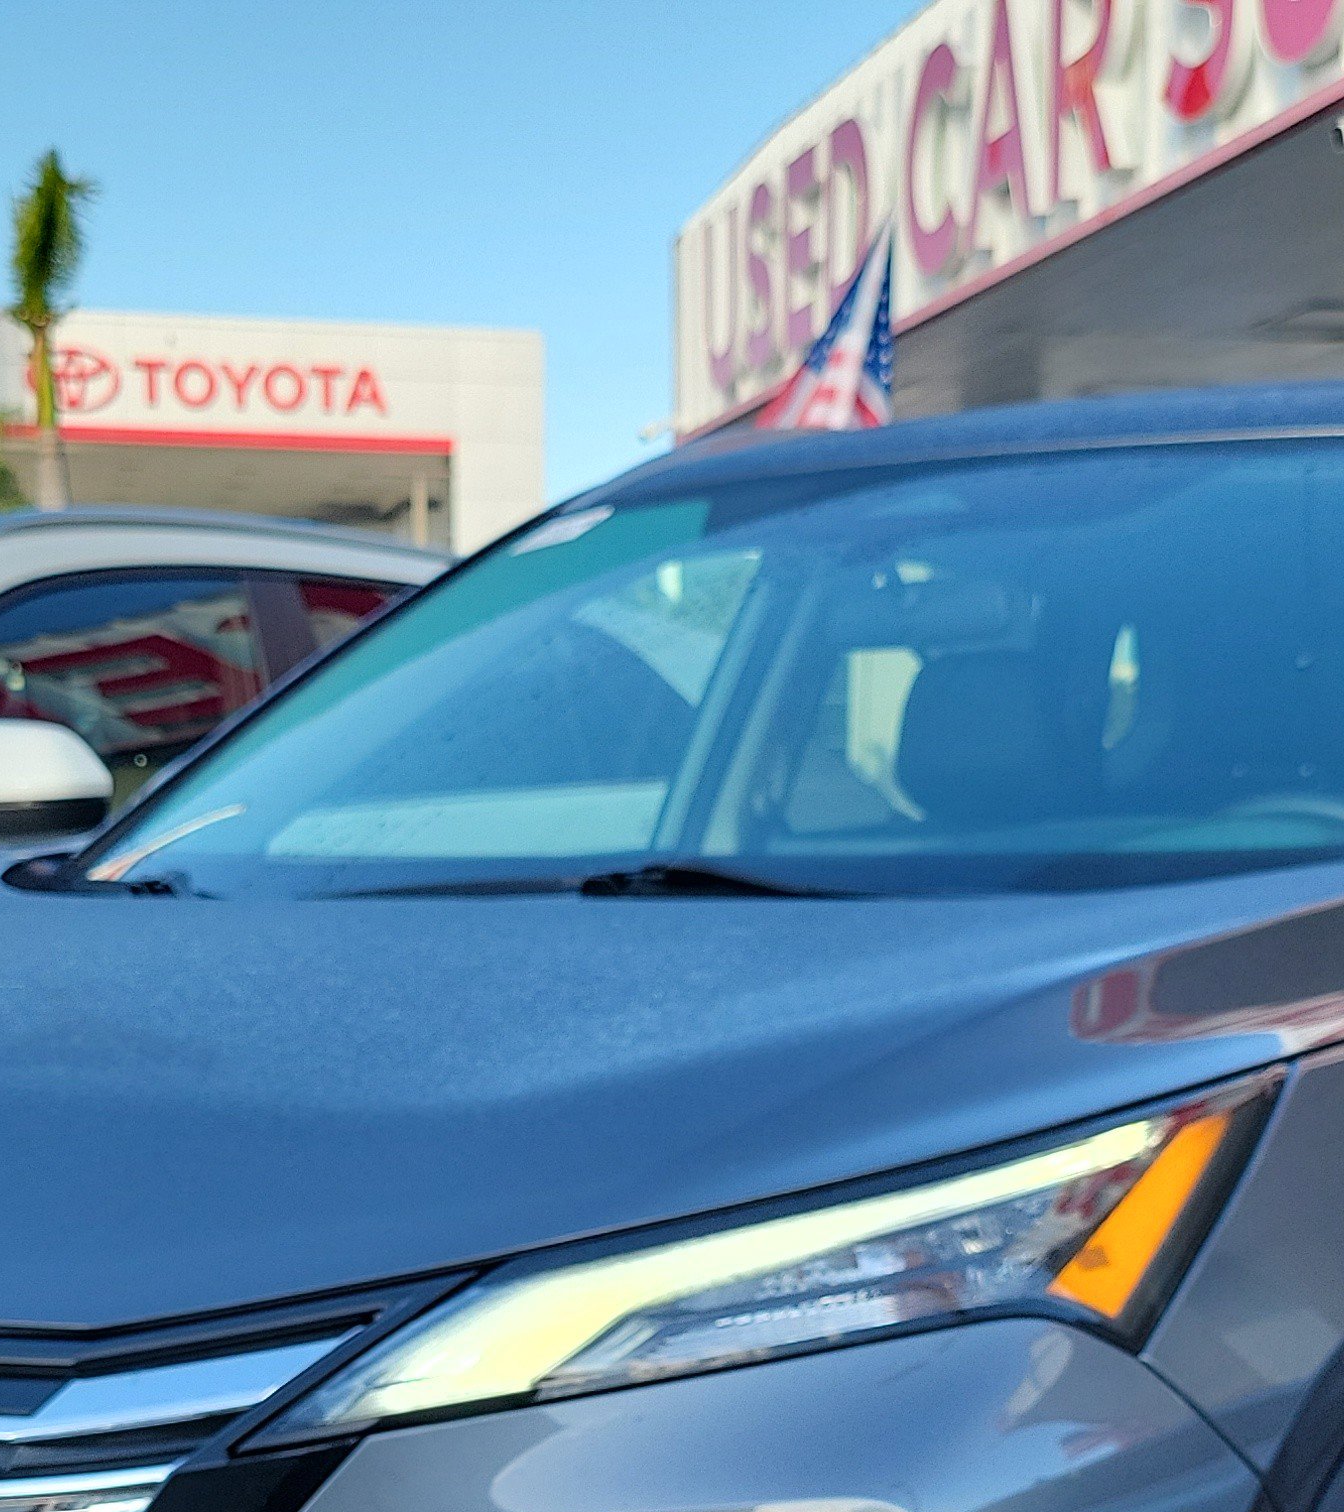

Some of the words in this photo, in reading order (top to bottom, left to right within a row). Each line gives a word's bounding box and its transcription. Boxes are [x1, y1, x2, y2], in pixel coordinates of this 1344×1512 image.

[702, 117, 870, 388] USED
[905, 0, 1116, 276] CAR
[134, 360, 387, 415] TOYOTA
